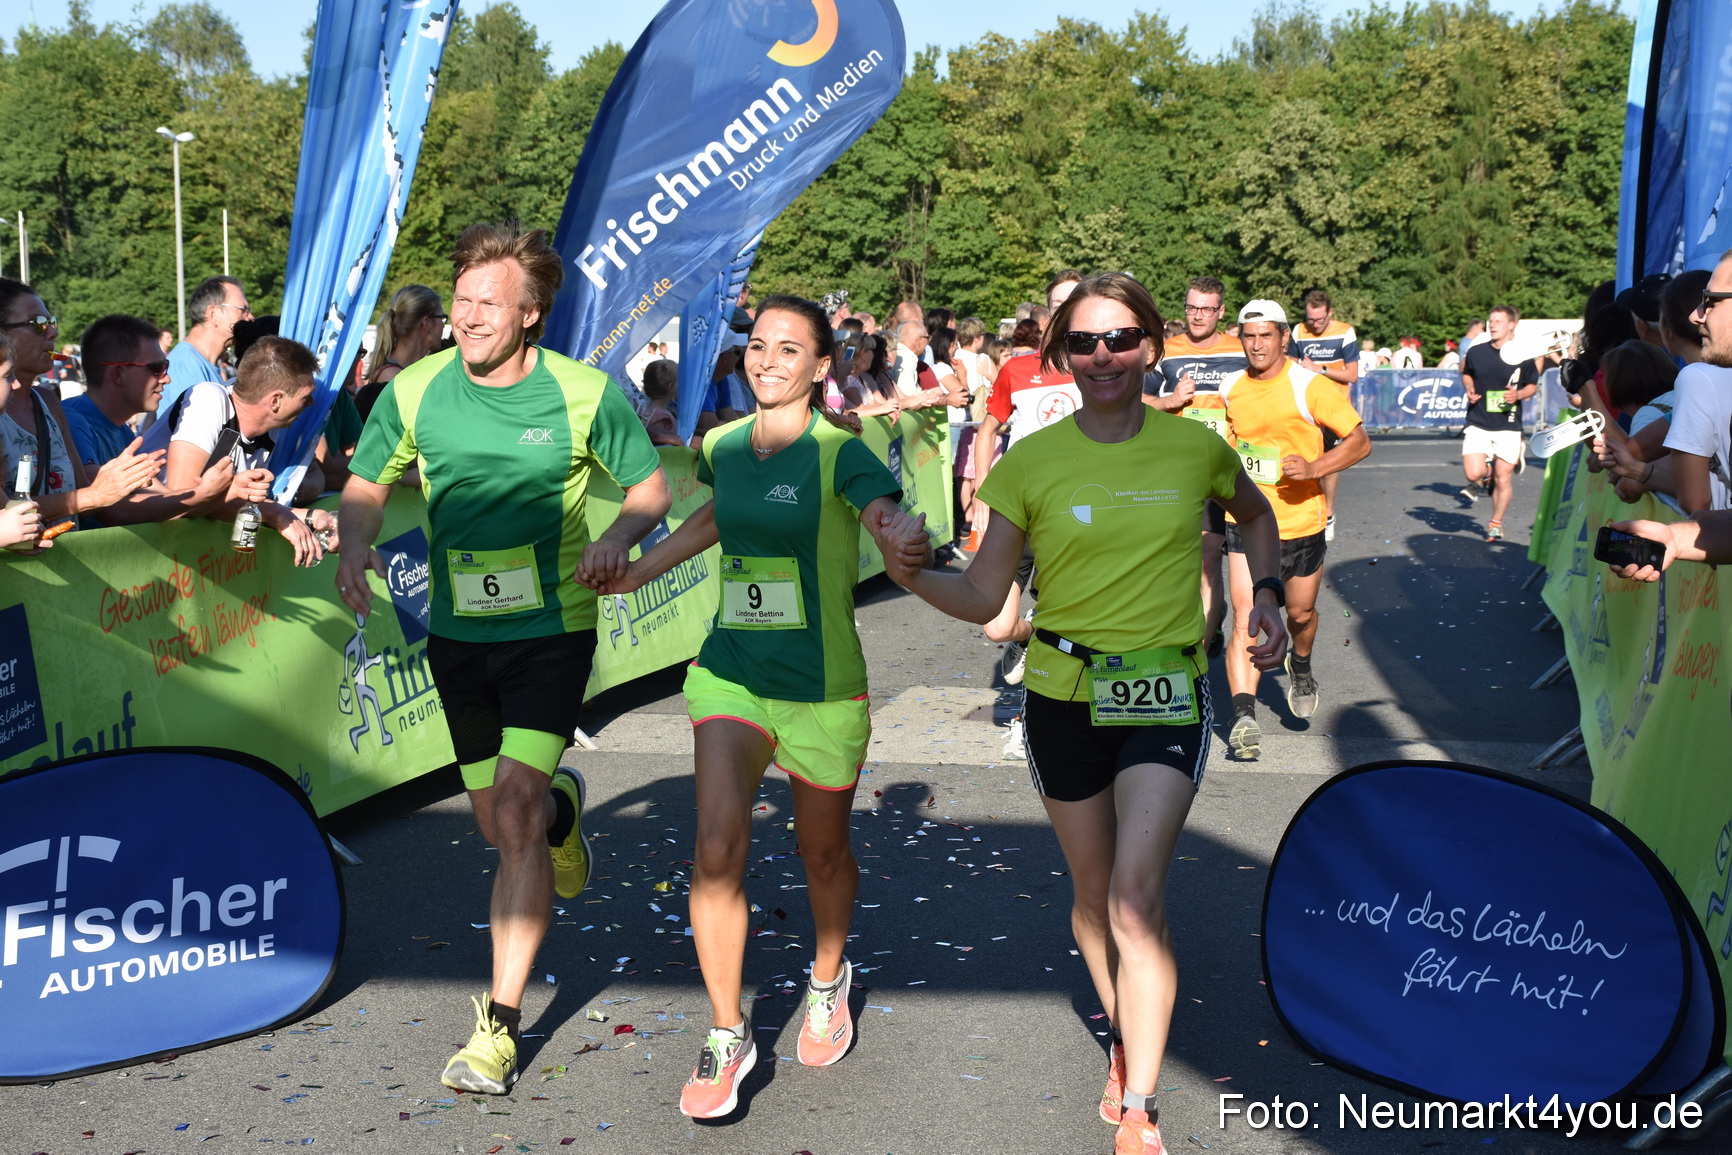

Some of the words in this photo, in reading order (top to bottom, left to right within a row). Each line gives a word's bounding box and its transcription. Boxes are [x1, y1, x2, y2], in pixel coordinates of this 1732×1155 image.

[727, 137, 784, 192] Druck
[783, 104, 821, 143] und
[816, 48, 884, 109] Medien
[574, 77, 803, 290] Frischmann
[579, 278, 673, 366] hmann-net.de
[1187, 370, 1229, 379] Fische
[1416, 393, 1468, 410] Fisc
[1423, 411, 1467, 419] AUTOM
[518, 428, 554, 442] AOK
[766, 484, 800, 501] AOK
[197, 546, 258, 592] Firmen
[397, 562, 429, 590] Fische
[483, 574, 500, 597] 6
[494, 594, 524, 604] Gerhard
[747, 583, 763, 609] 9
[212, 575, 277, 648] länger!
[642, 602, 680, 637] neumarkt
[1141, 667, 1160, 676] 2018
[1111, 677, 1173, 706] 920
[5, 700, 36, 723] Lächeln
[399, 695, 444, 732] neuma
[0, 726, 16, 745] ährt
[17, 713, 35, 732] mit!
[3, 877, 288, 967] Fischer
[1406, 890, 1466, 938] das
[1472, 903, 1628, 961] Lächeln
[39, 933, 276, 999] AUTOMOBILE
[1402, 947, 1501, 998] fährt
[1510, 973, 1605, 1016] mit!
